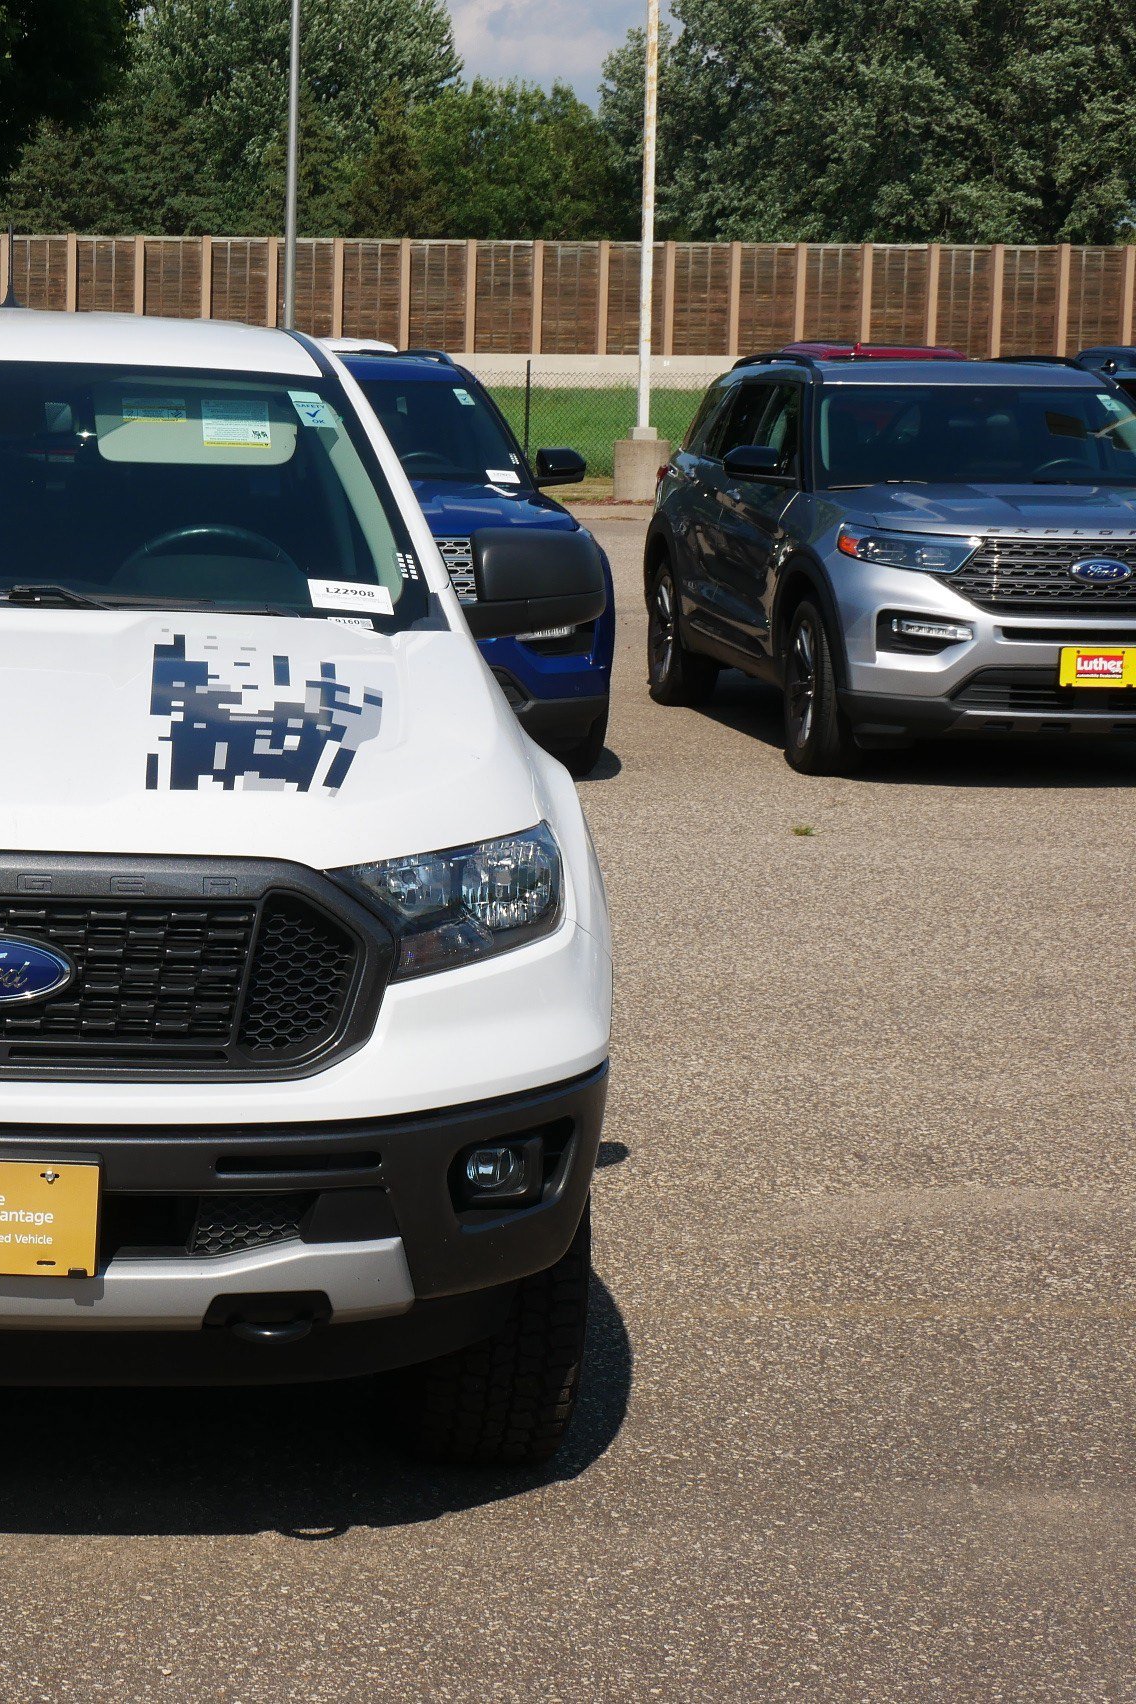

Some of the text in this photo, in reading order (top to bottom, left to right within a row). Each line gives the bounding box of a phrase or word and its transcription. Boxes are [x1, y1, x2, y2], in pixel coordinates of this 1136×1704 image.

[1087, 564, 1118, 577] Ford
[325, 587, 375, 597] L22908
[1076, 657, 1123, 671] Luther
[15, 1233, 53, 1245] Vehicle
